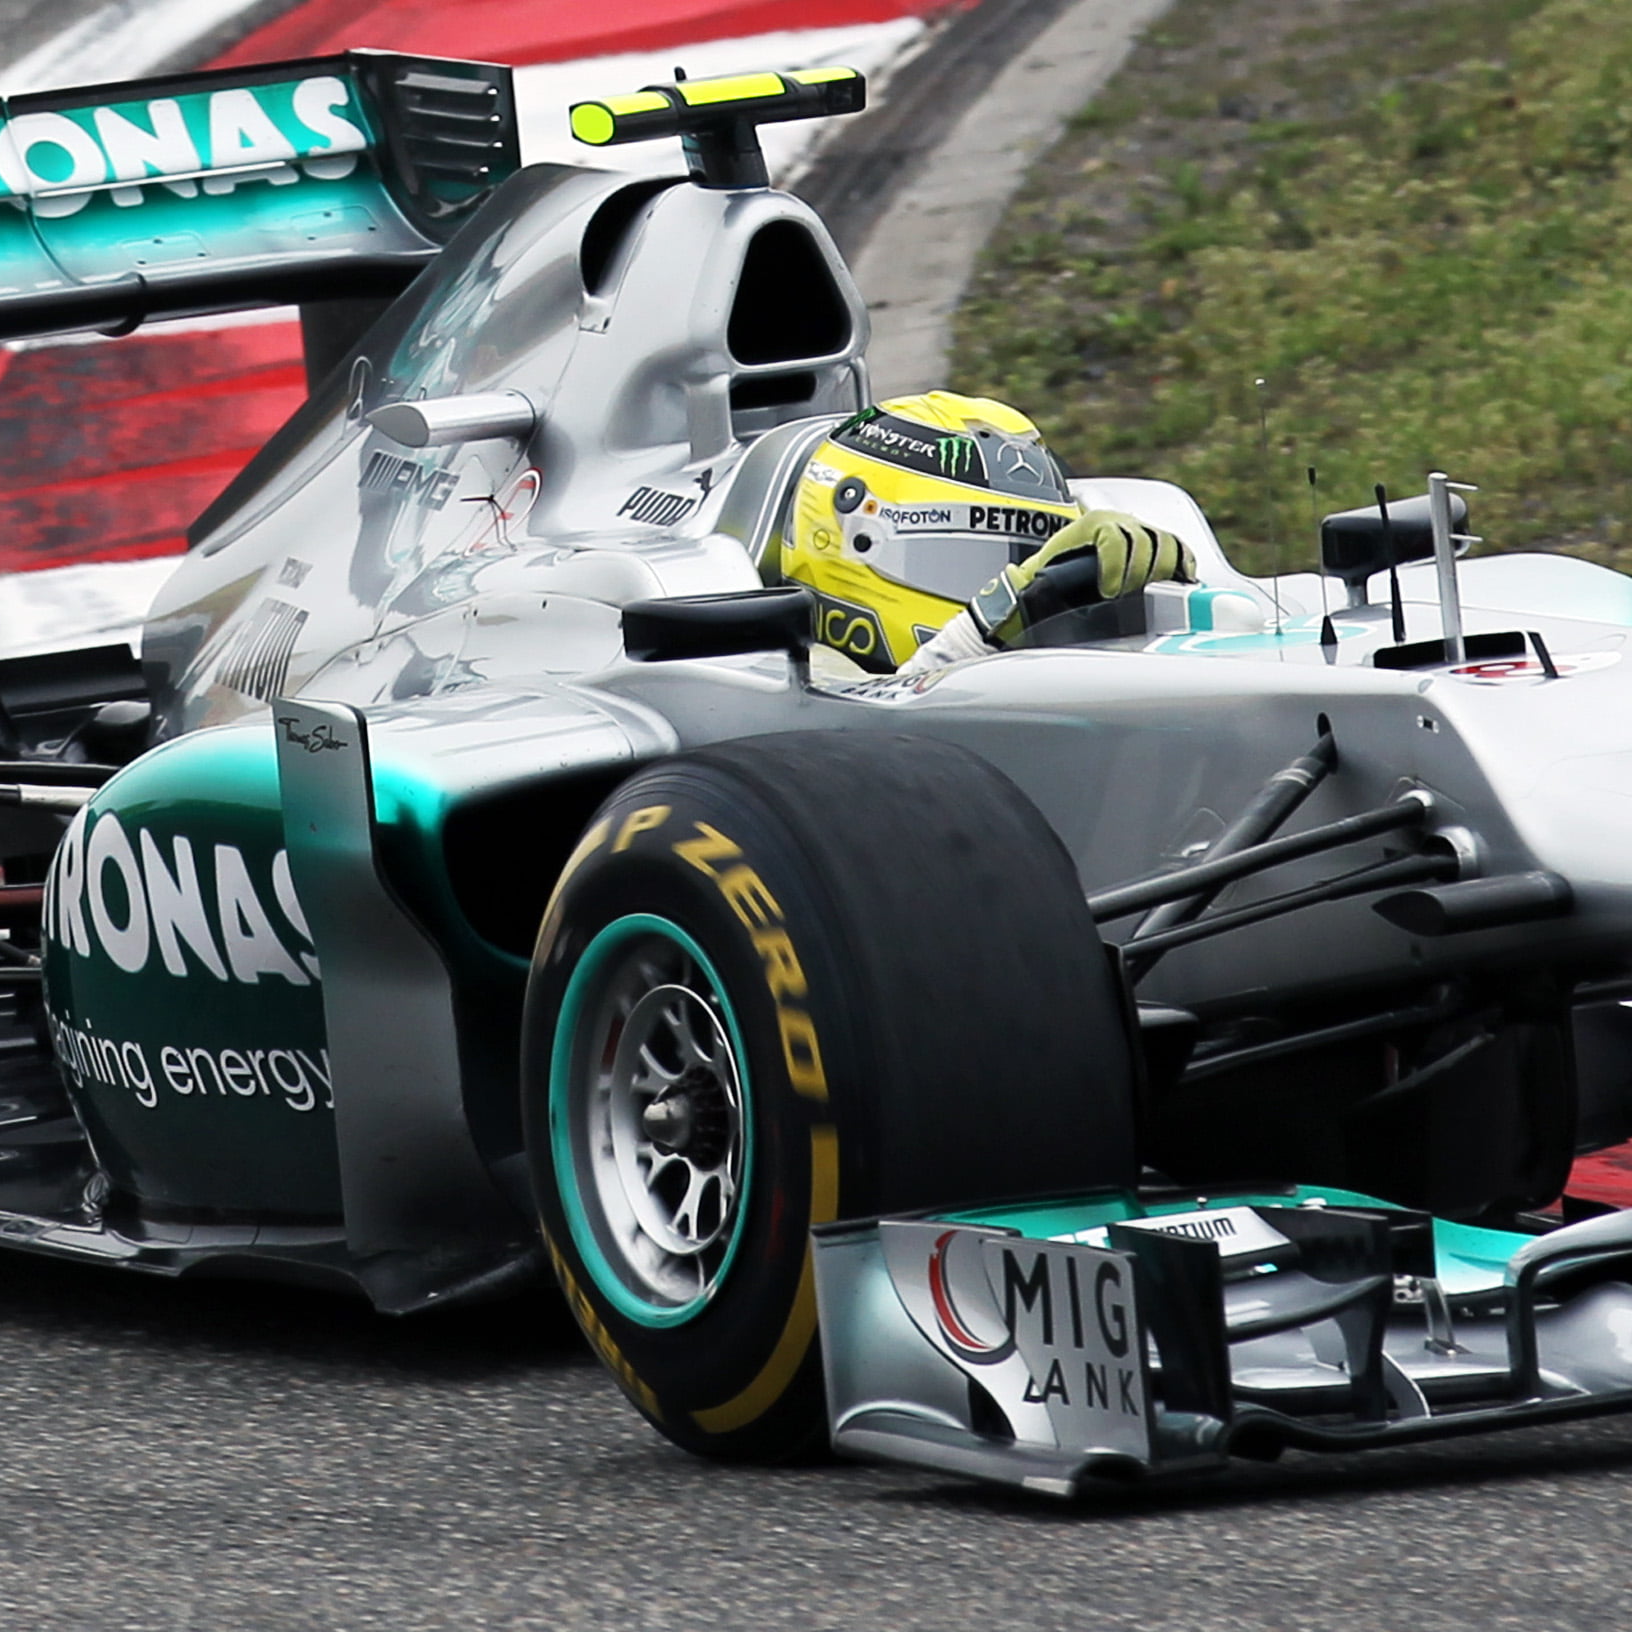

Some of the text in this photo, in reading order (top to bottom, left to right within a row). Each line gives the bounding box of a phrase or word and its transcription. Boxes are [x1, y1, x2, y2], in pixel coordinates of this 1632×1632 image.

[857, 421, 936, 457] MONSTER
[616, 486, 696, 528] PUMA
[879, 507, 951, 524] ISOFOTON
[970, 506, 1074, 538] PETRON
[611, 805, 830, 1101] P ZERO
[161, 1046, 335, 1111] energy
[1002, 1249, 1130, 1358] MIG
